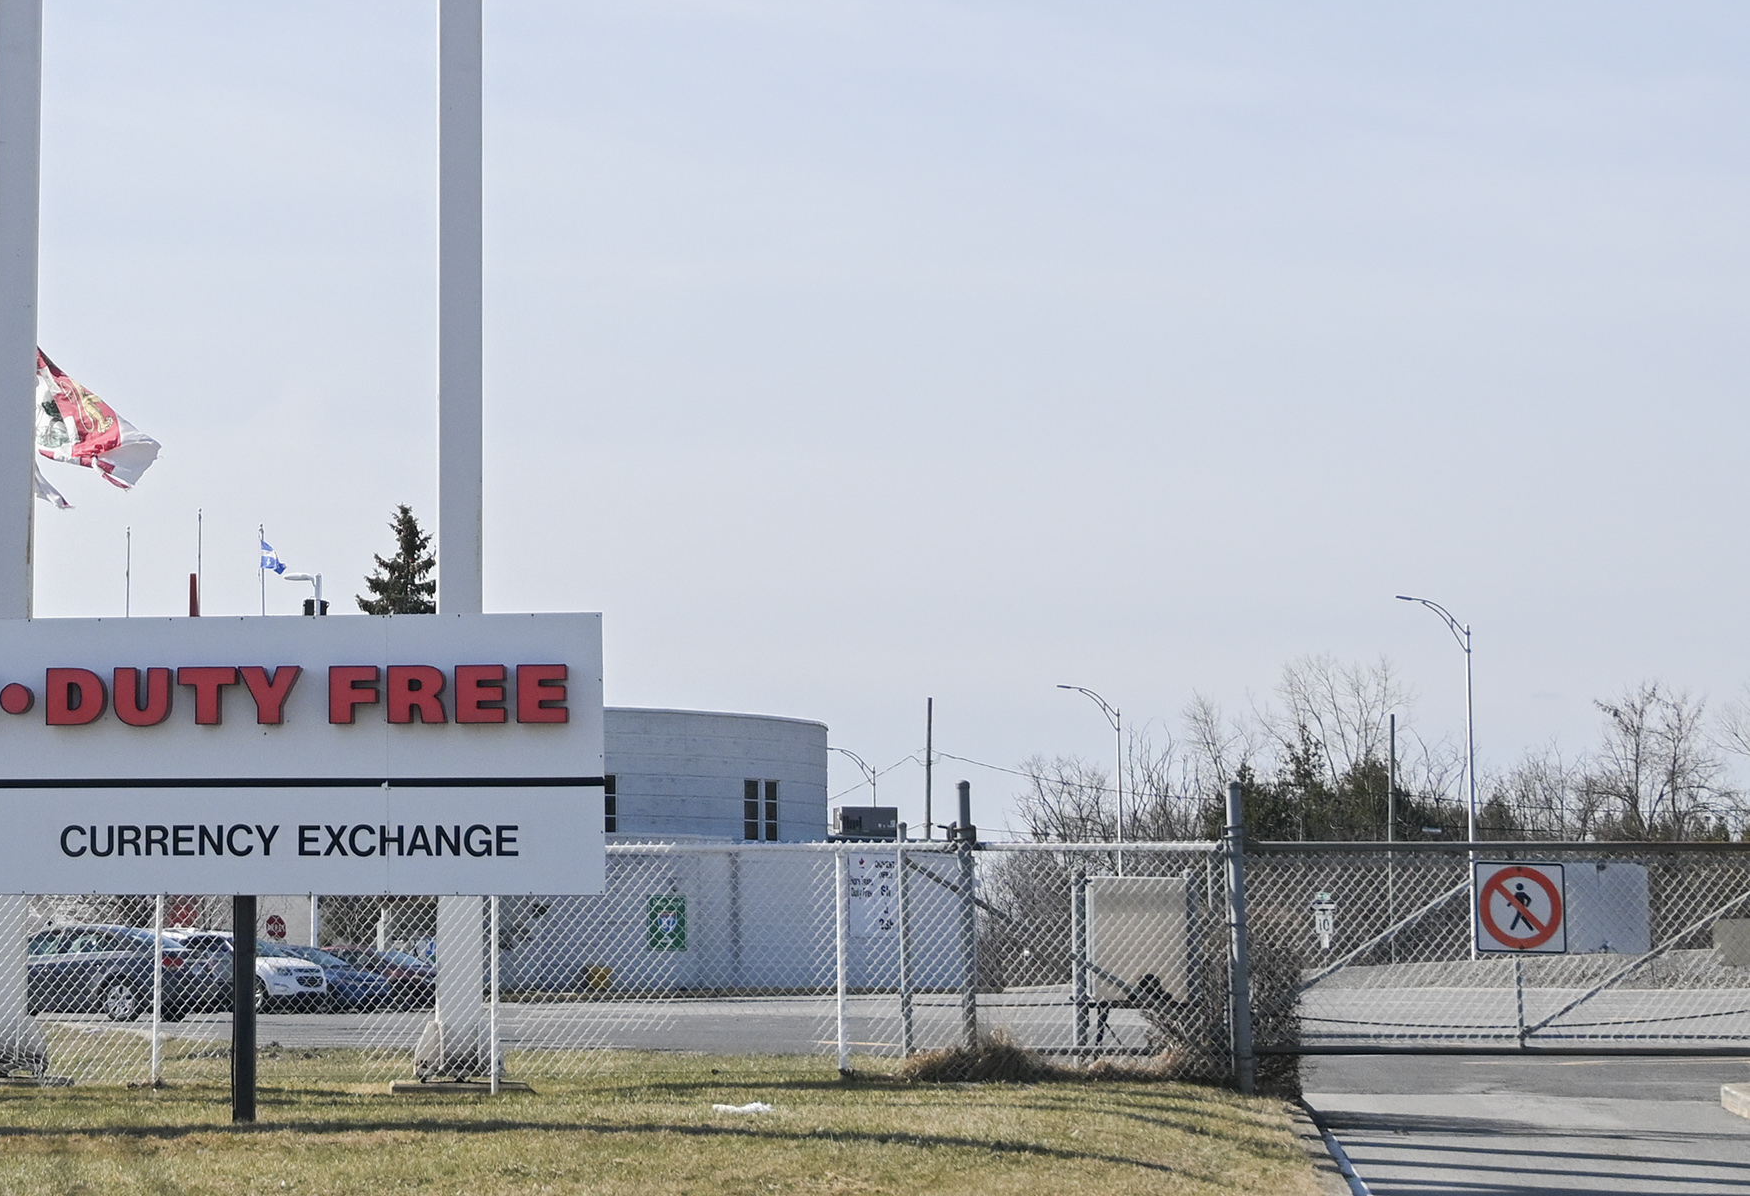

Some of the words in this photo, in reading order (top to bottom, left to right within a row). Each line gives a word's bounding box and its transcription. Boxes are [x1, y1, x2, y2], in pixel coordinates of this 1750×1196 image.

[46, 666, 301, 728] DUTY
[329, 664, 569, 726] FREE
[60, 824, 280, 858] CURRENCY
[298, 823, 519, 858] EXCHANGE
[1318, 918, 1330, 932] 10
